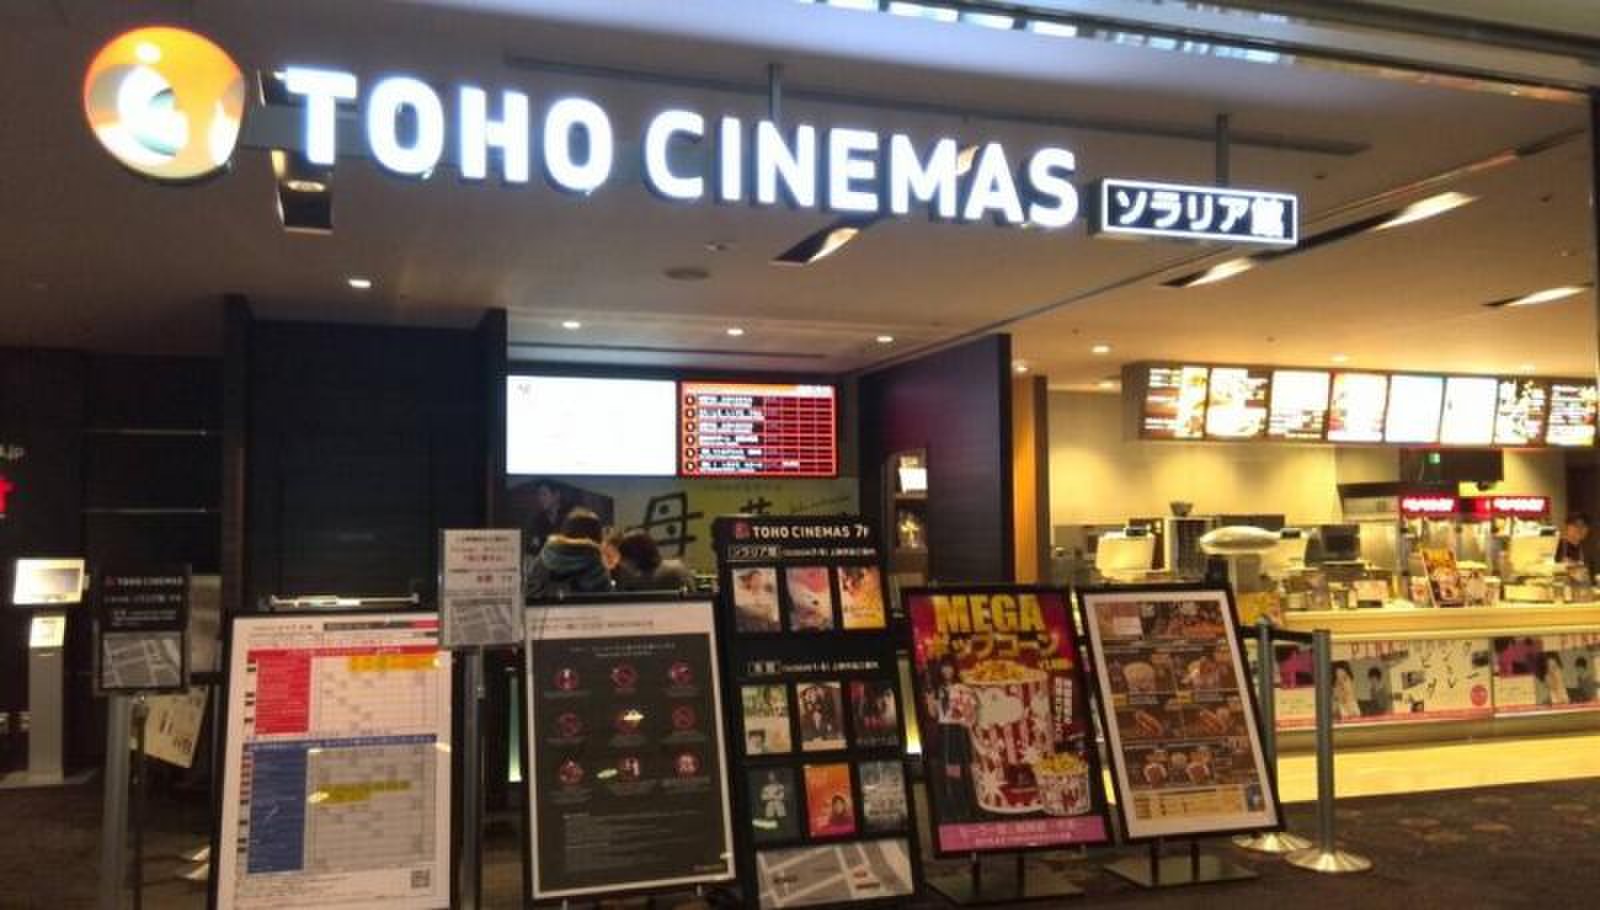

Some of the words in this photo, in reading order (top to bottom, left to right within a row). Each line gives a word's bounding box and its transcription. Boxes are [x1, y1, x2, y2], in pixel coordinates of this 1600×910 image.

[282, 68, 612, 192] TOHO
[646, 110, 1077, 228] CINEMAS
[752, 526, 789, 538] TOHO
[791, 525, 850, 538] CINEMAS
[932, 595, 1045, 633] MEGA
